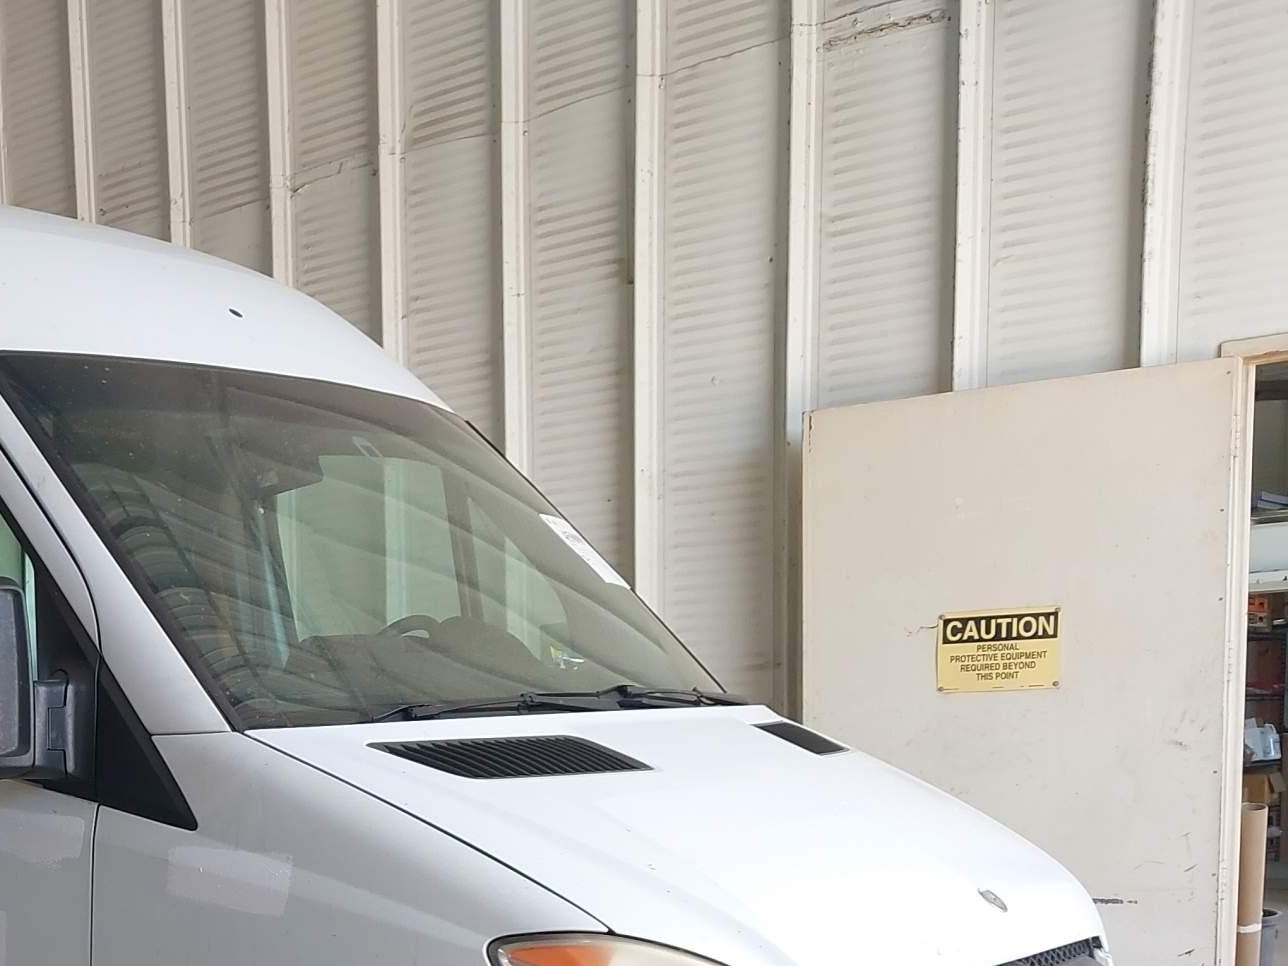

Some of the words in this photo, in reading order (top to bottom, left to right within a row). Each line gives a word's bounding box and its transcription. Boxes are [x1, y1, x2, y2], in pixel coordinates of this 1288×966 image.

[946, 615, 1055, 641] CAUTION
[976, 643, 1020, 652] PERSONAL
[950, 654, 998, 663] PROTECTIVE
[1000, 651, 1047, 661] EQUIPMENT
[960, 663, 1000, 672] REQUIRED
[1002, 661, 1036, 670] BEYOND
[976, 673, 994, 681] THIS
[995, 671, 1019, 680] POINT
